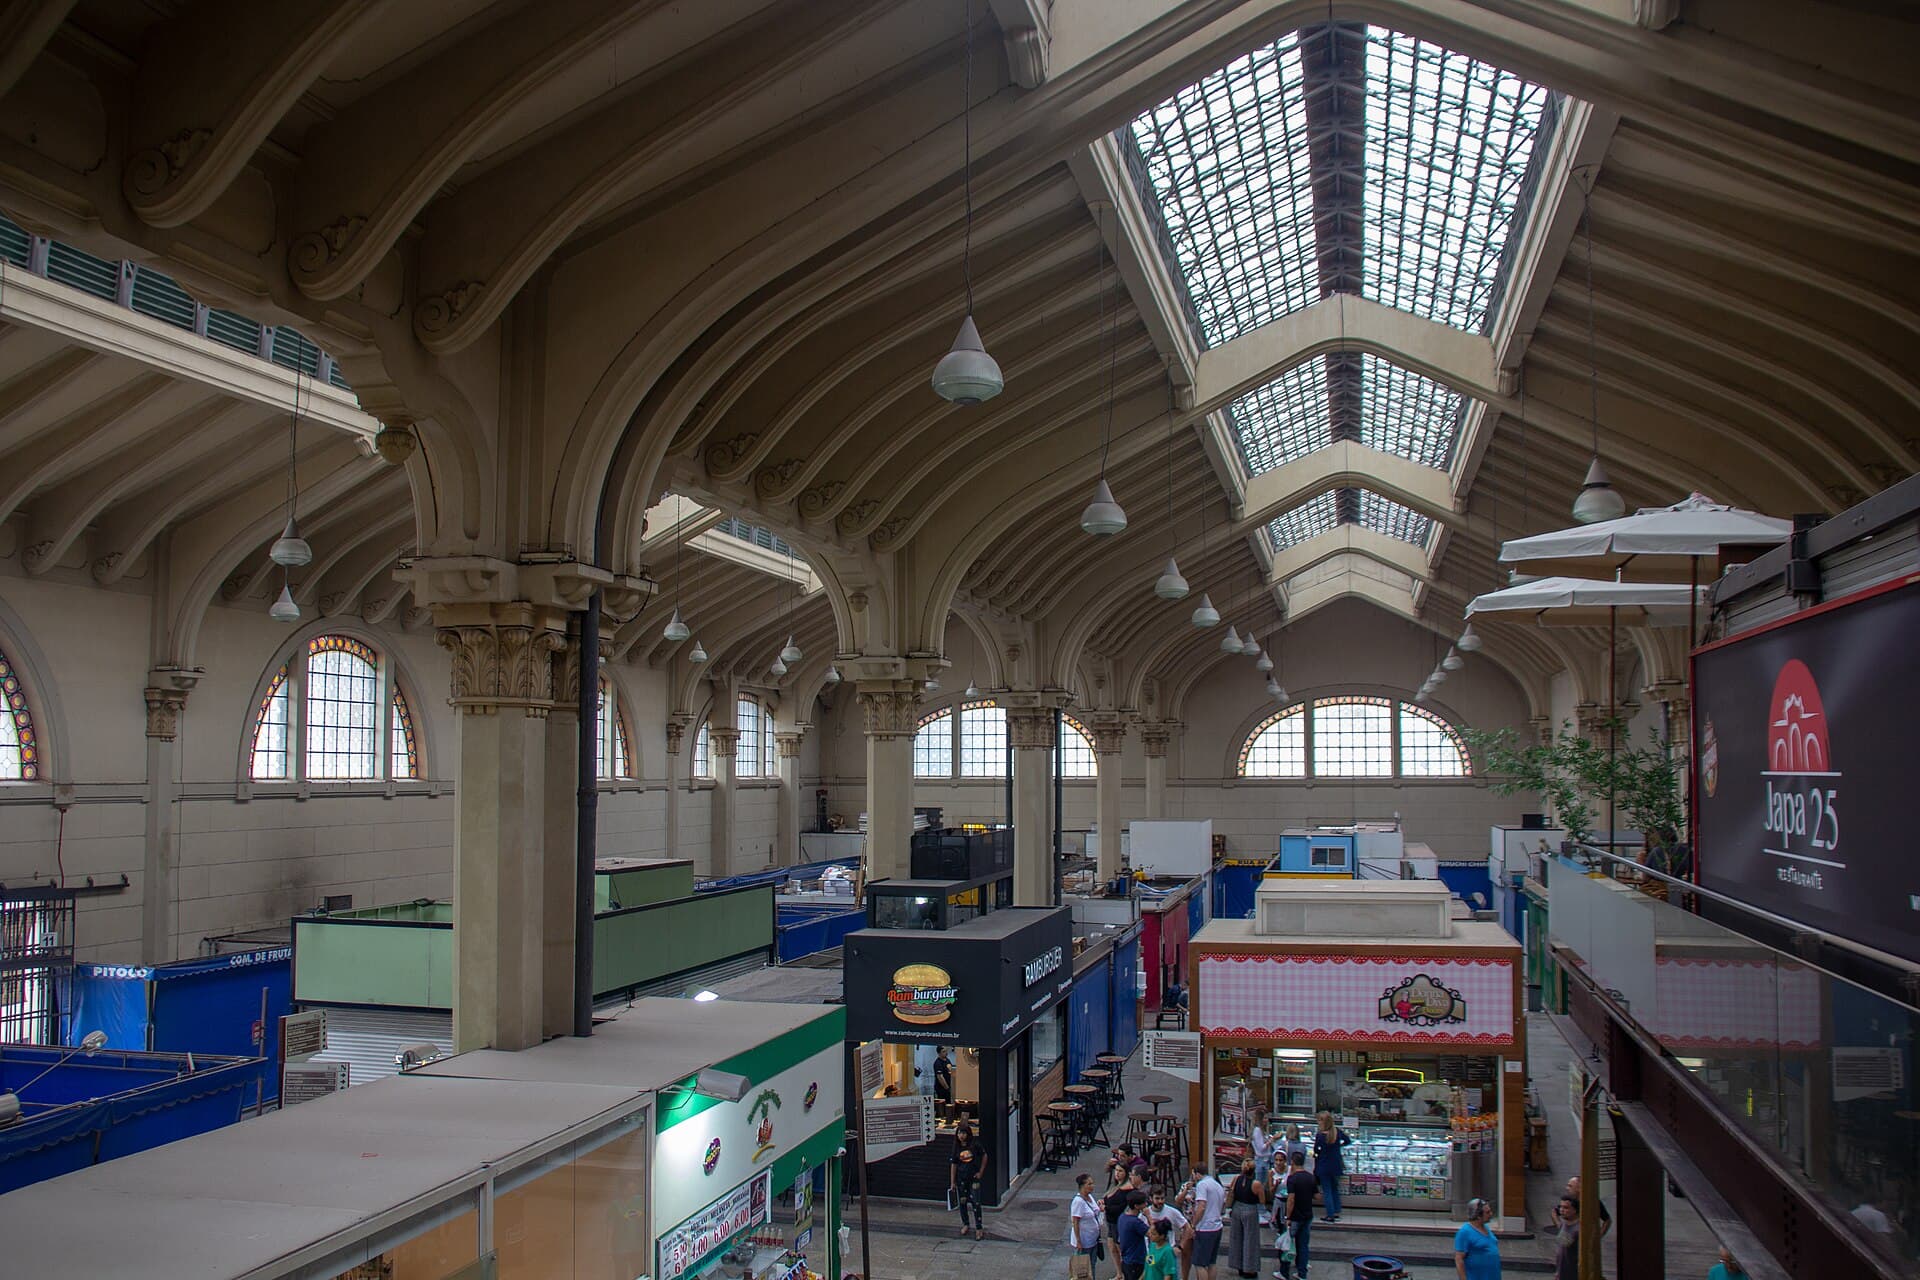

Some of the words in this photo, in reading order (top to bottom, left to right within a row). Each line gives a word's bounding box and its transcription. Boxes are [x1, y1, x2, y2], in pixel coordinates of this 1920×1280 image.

[1763, 780, 1806, 848] Japa
[1810, 787, 1839, 851] 25
[1776, 865, 1824, 890] RESTAURANTE
[42, 935, 54, 947] 11
[230, 953, 253, 967] COM.
[255, 951, 267, 961] DE
[1025, 946, 1063, 988] RAMBURGUER
[887, 988, 958, 1003] Ramburguer
[734, 1207, 749, 1229] 6,00
[713, 1220, 730, 1243] 6,00
[690, 1235, 708, 1259] 4,00
